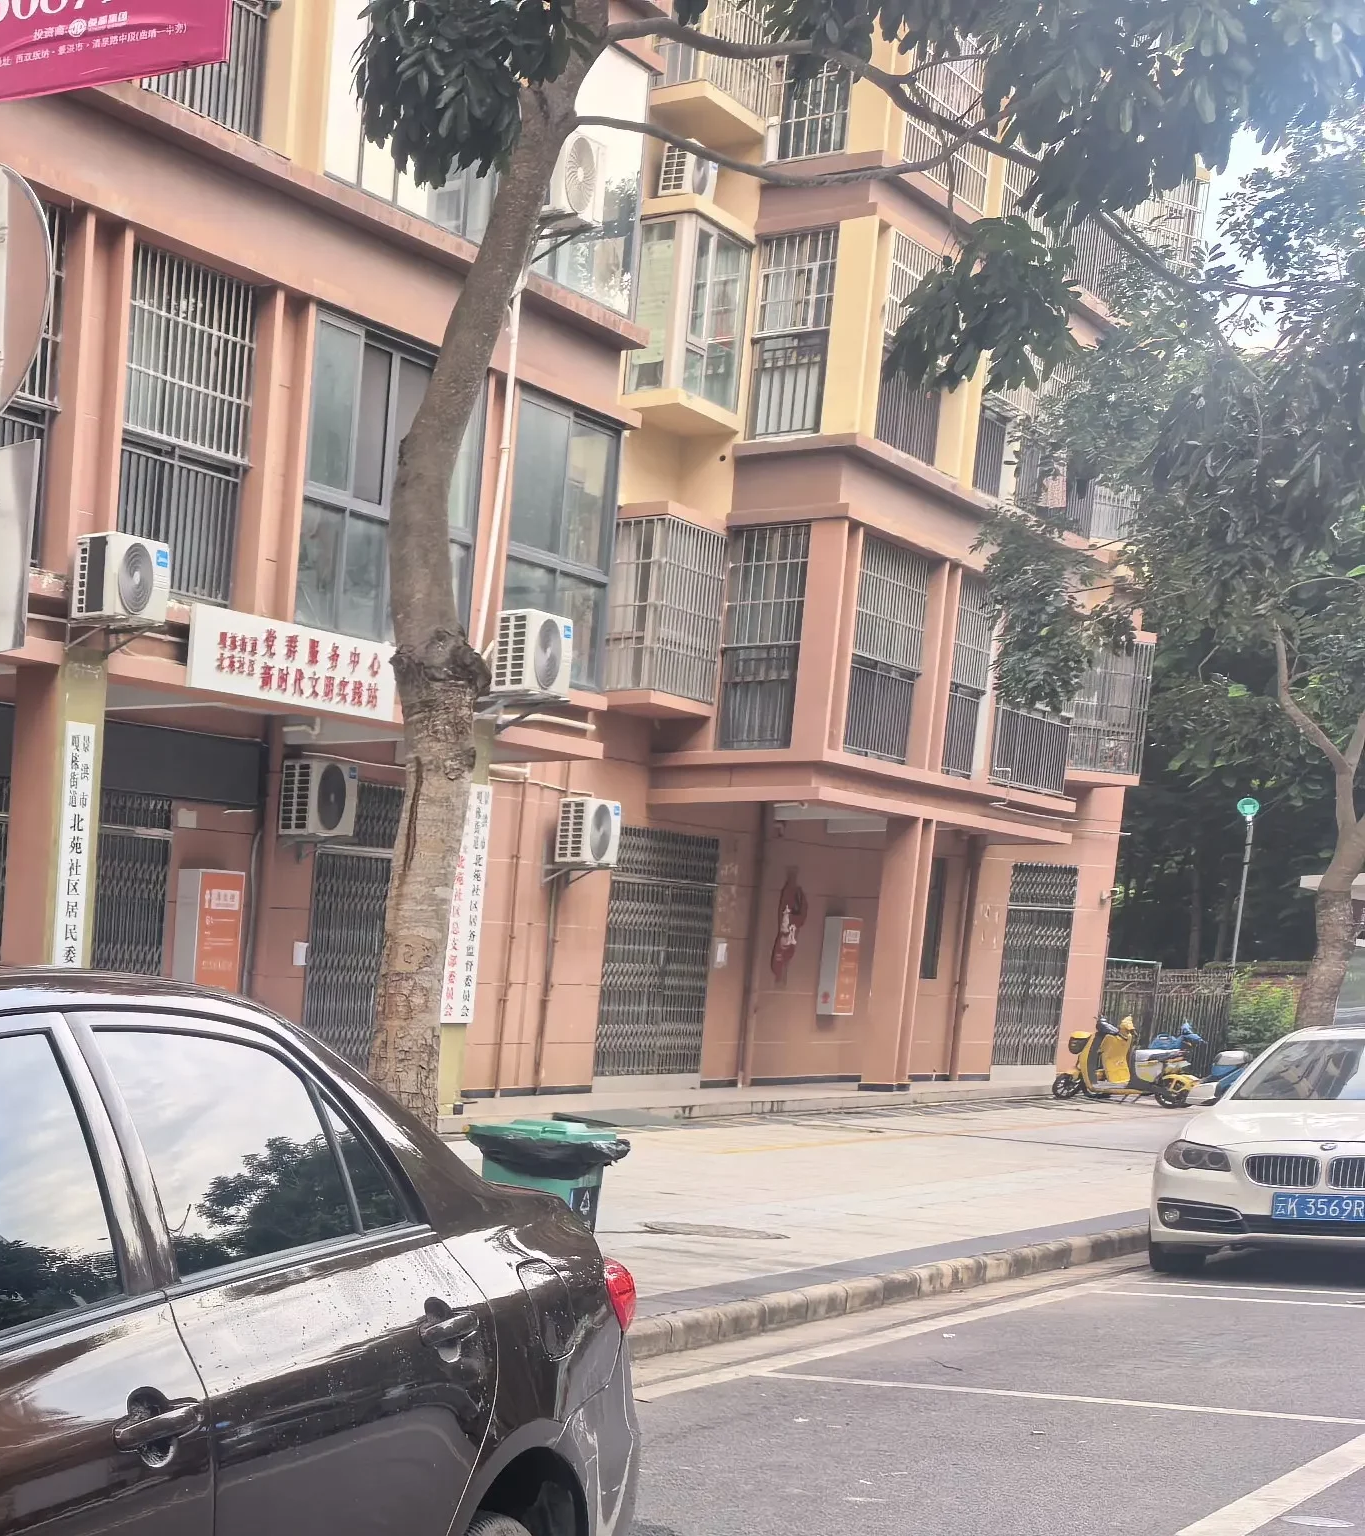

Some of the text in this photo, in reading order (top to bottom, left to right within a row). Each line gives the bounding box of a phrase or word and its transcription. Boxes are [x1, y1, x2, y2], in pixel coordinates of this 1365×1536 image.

[262, 628, 381, 678] 党群服务中心
[258, 662, 380, 710] 新时代文明实践站
